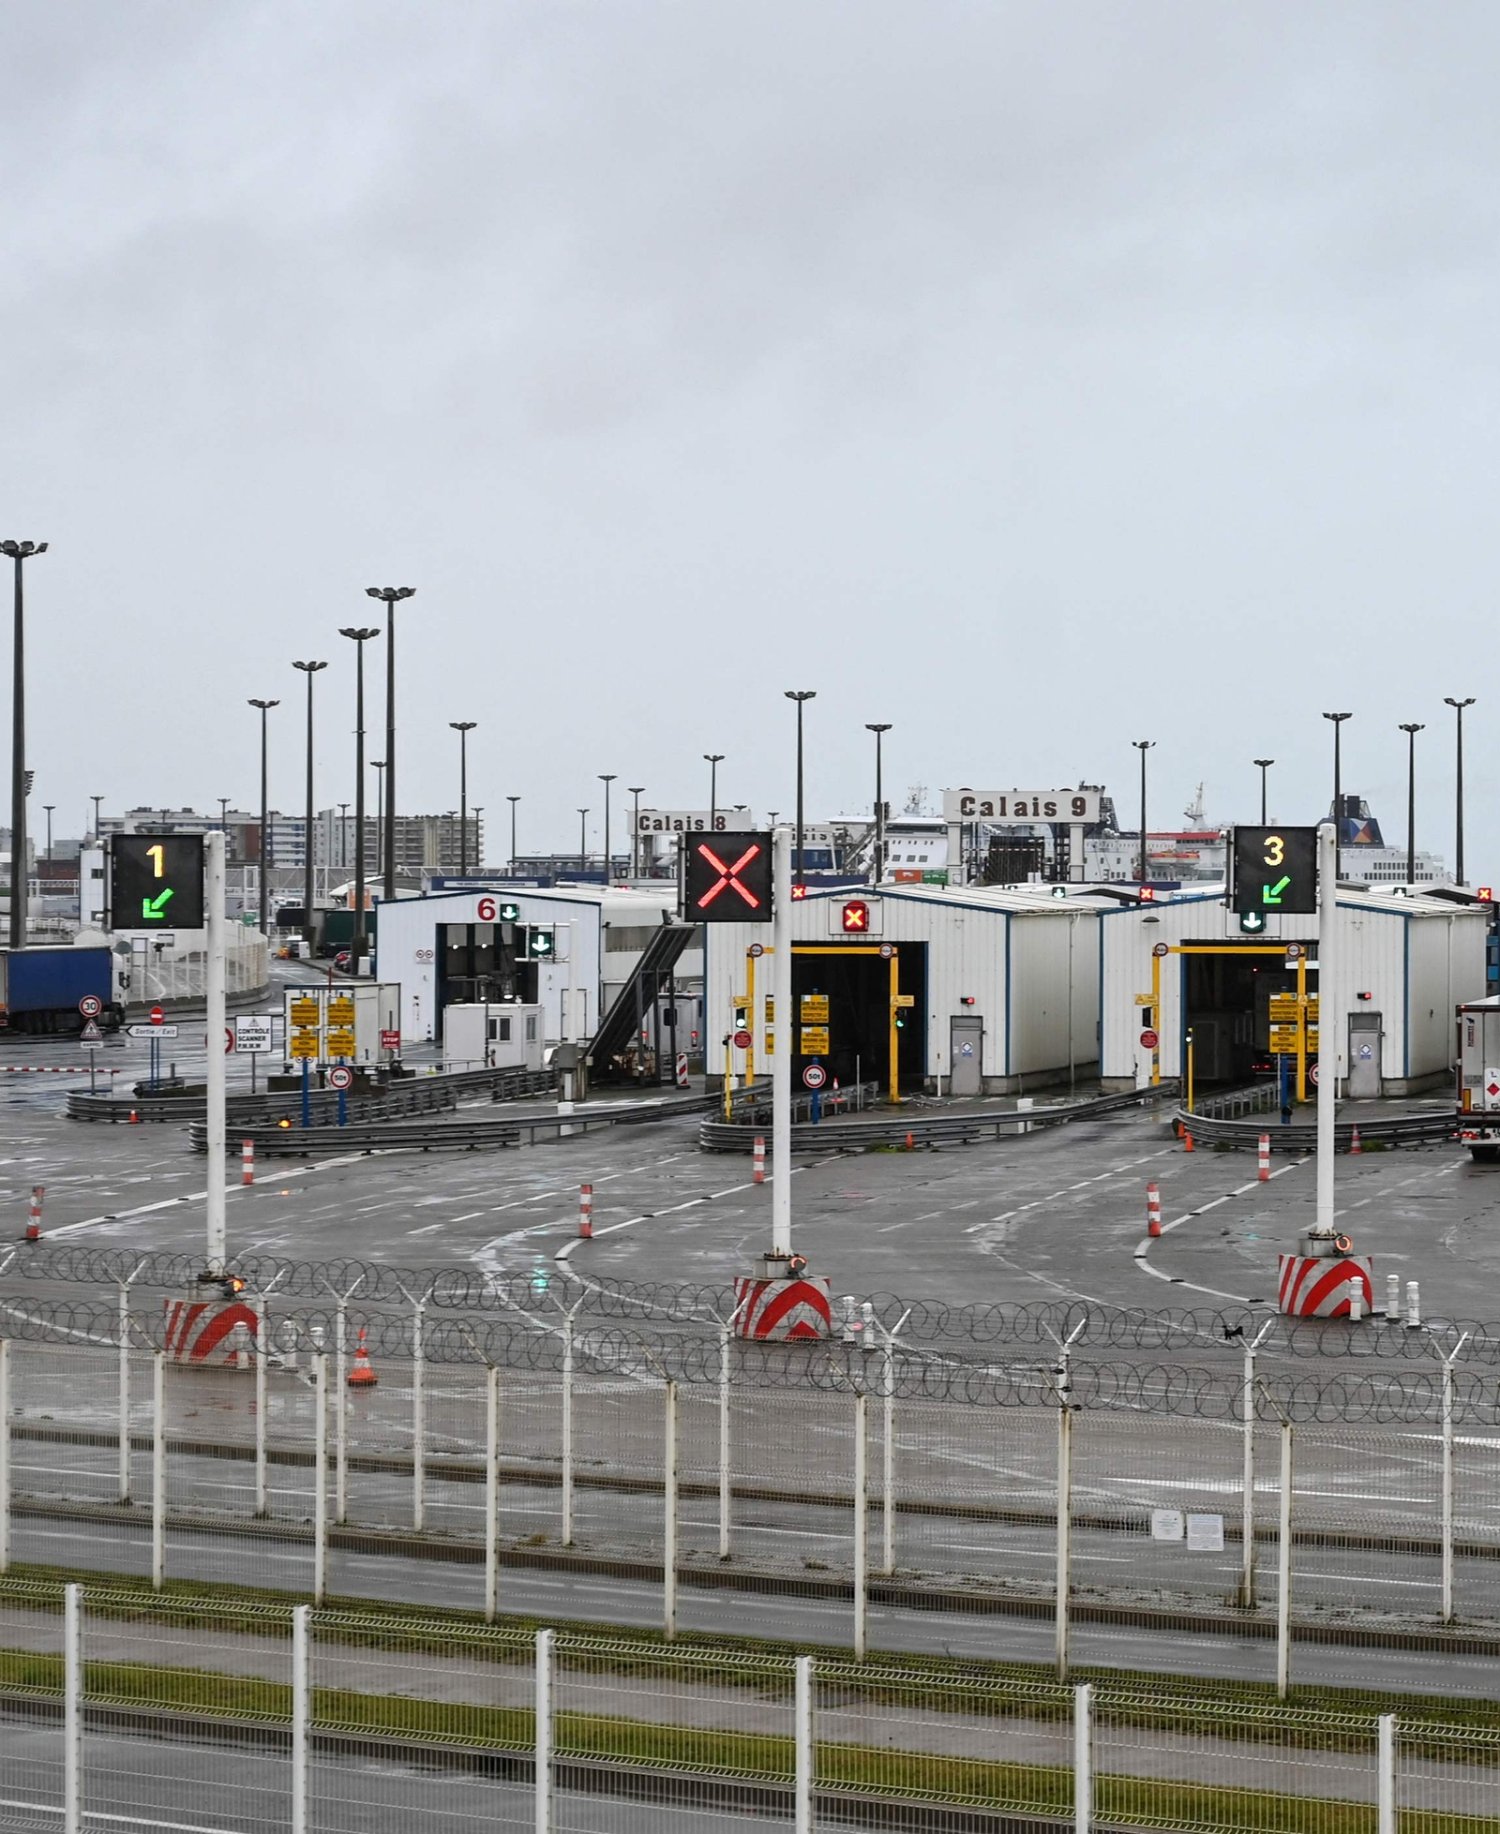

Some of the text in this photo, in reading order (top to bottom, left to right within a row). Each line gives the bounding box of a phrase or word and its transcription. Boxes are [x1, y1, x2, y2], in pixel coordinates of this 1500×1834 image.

[960, 796, 1087, 817] Calais 9
[639, 815, 727, 831] Calais 8
[145, 844, 163, 877] 1
[1263, 835, 1284, 867] 3
[477, 897, 496, 921] 6
[84, 1002, 97, 1011] 30
